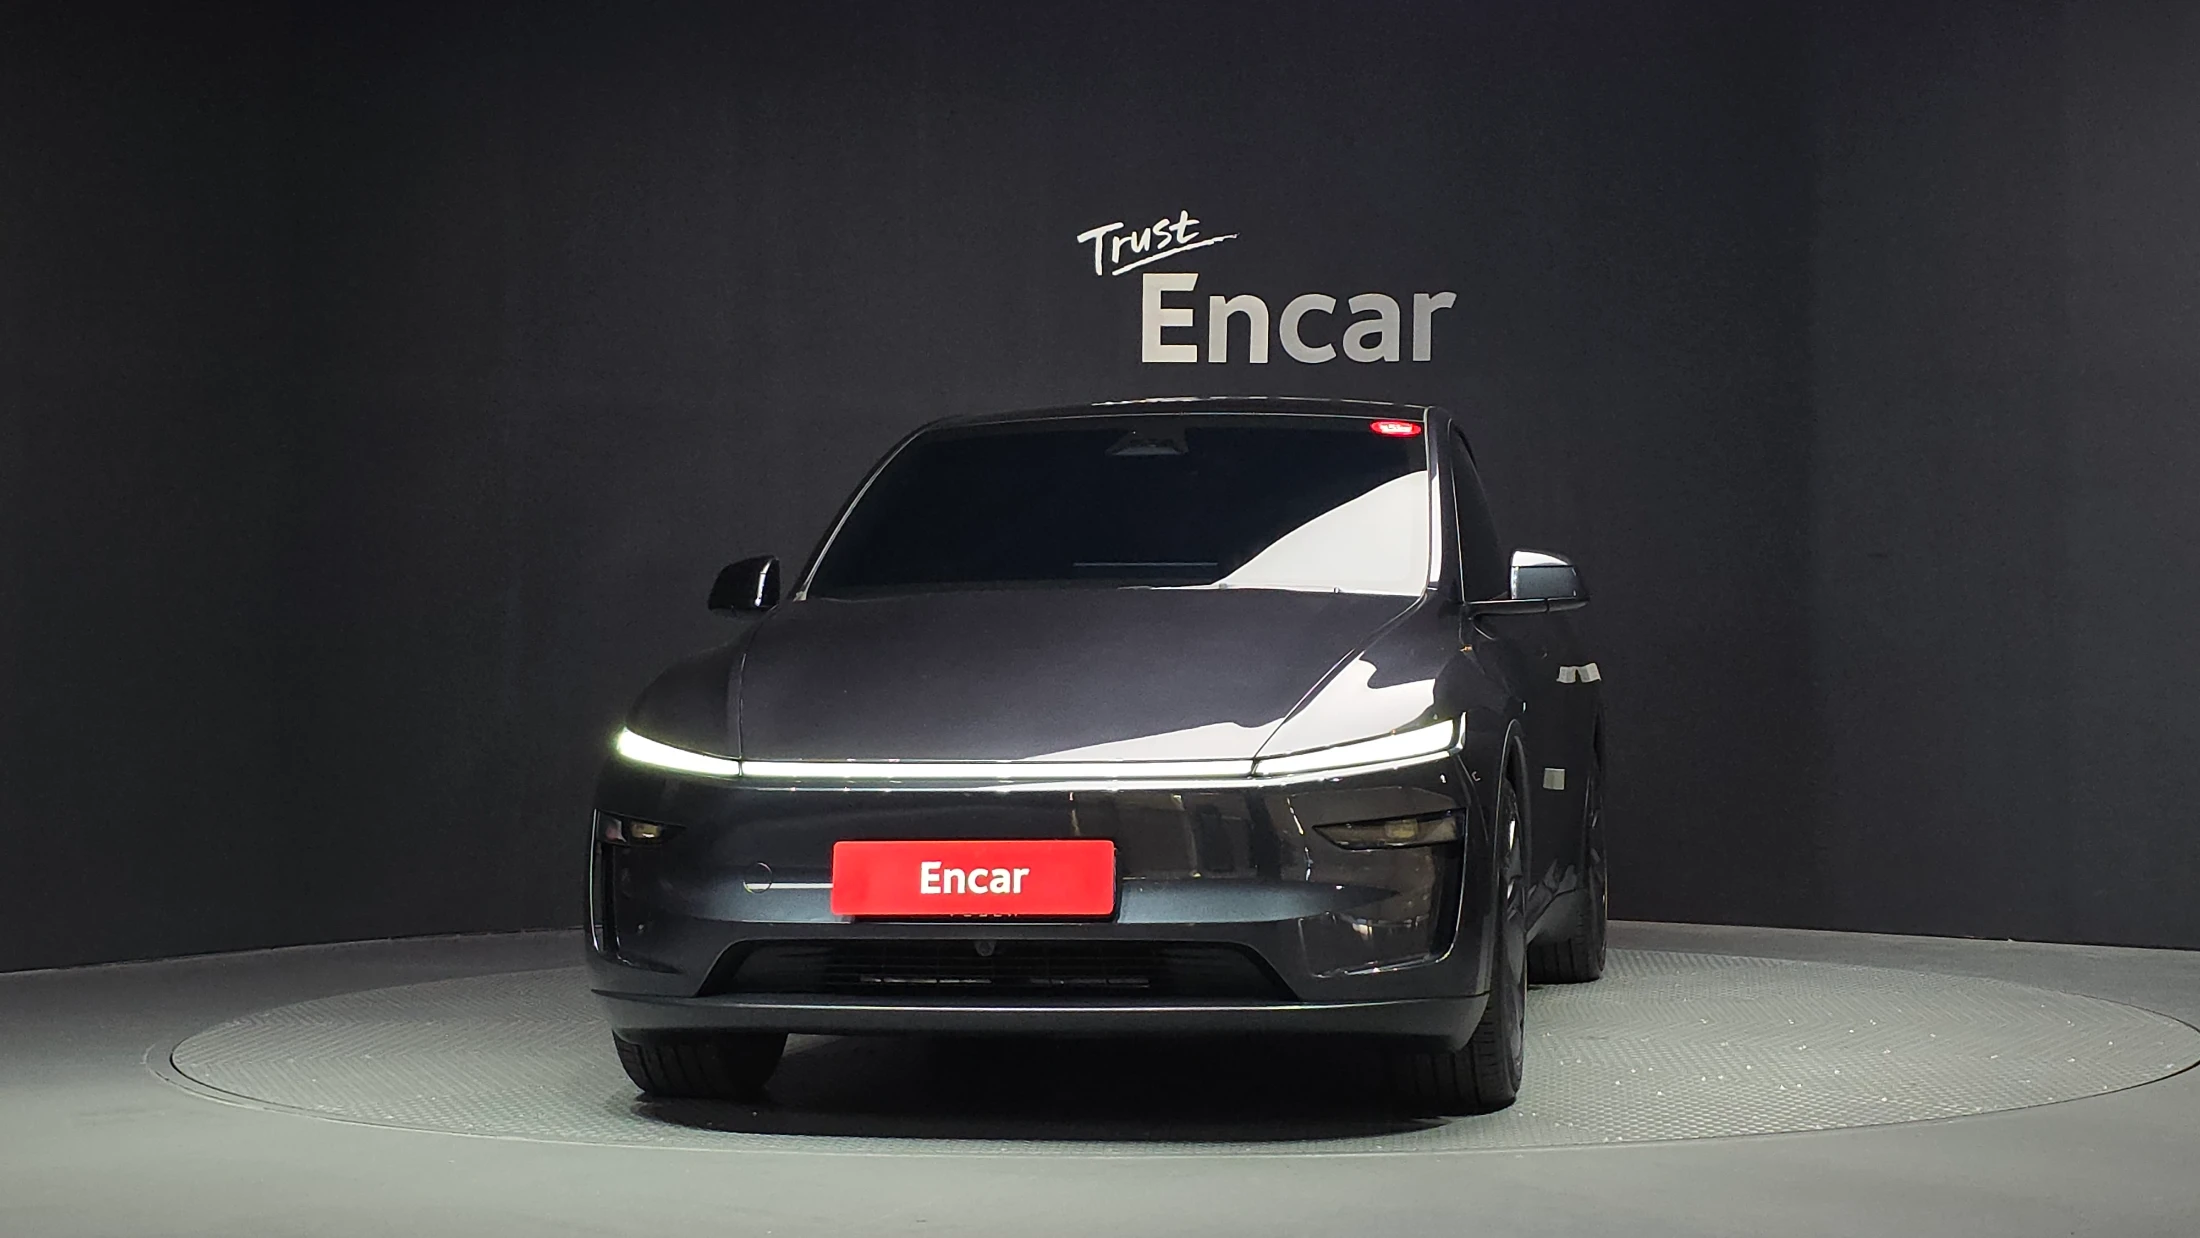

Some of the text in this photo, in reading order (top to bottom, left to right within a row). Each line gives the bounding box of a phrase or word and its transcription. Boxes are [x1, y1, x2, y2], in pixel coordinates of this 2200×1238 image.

[1077, 210, 1201, 276] Trust
[1142, 272, 1457, 363] Encar
[920, 861, 1030, 895] Encar
